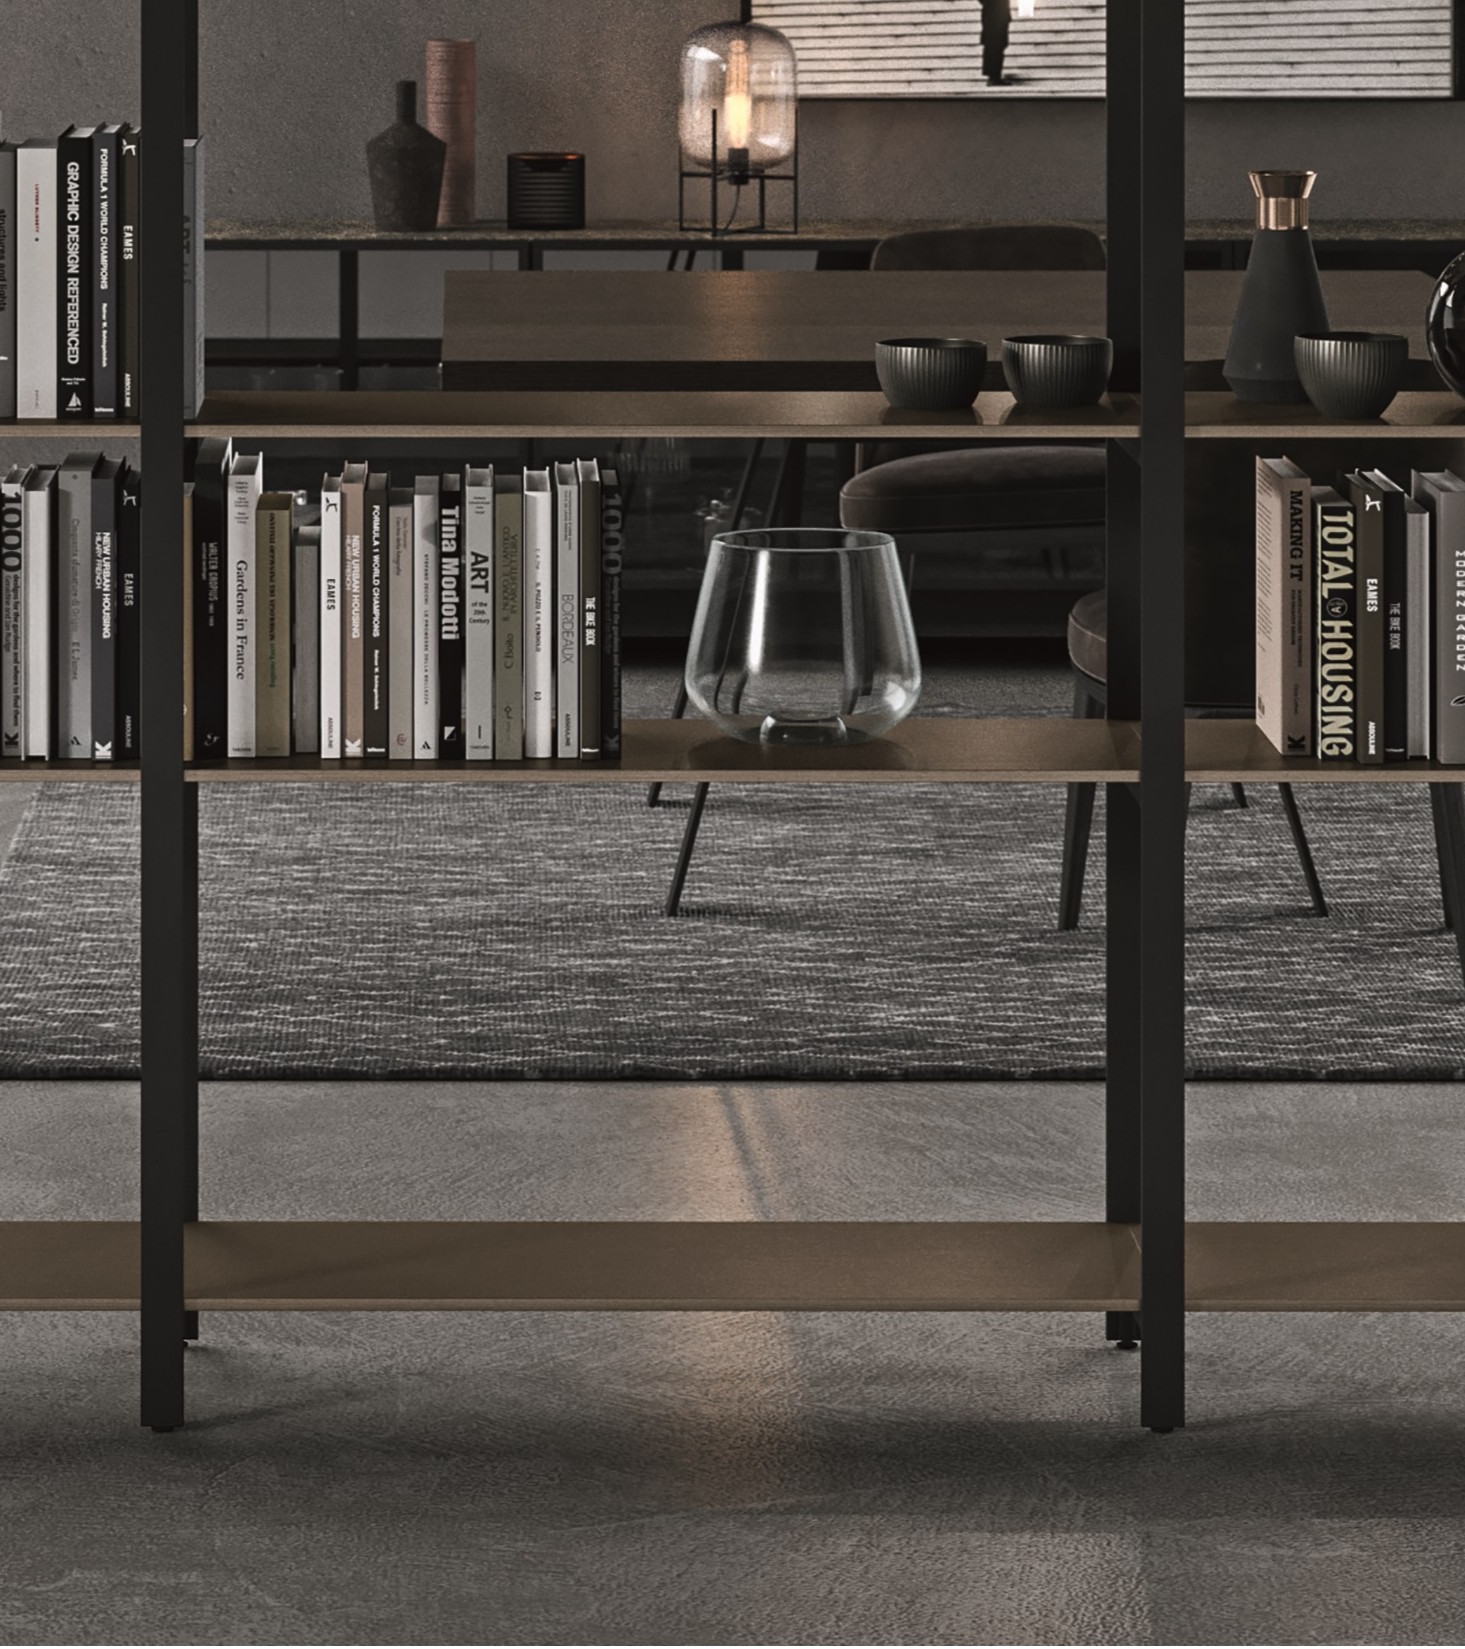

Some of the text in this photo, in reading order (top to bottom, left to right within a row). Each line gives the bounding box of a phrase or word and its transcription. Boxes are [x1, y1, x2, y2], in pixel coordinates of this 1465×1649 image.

[122, 225, 133, 260] EAMES
[1321, 511, 1354, 756] TOTAL HOUSING
